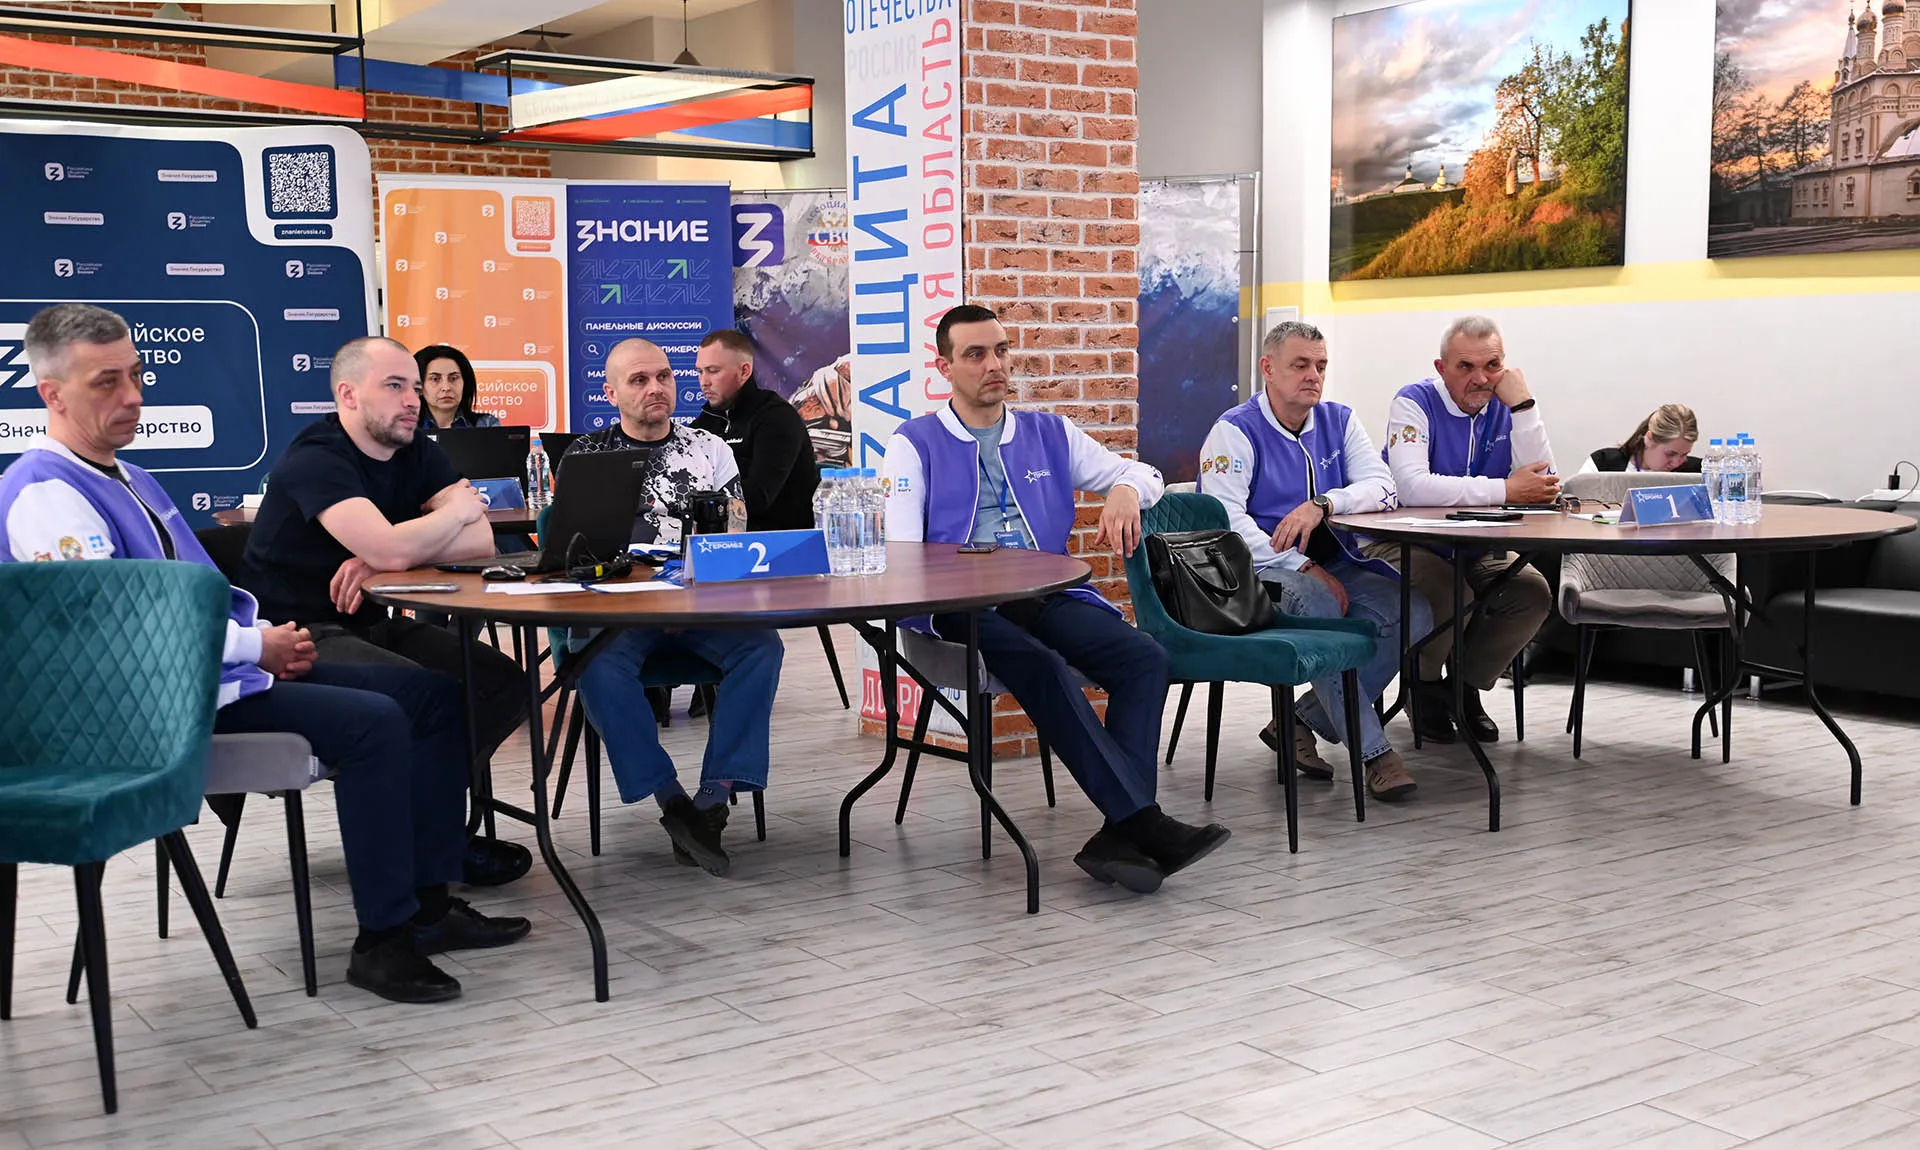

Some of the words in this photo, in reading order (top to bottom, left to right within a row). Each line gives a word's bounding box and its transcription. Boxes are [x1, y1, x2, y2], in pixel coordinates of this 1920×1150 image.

[846, 0, 952, 34] ОТЕЧЕС
[921, 18, 955, 249] ОБЛАСТЬ
[129, 323, 205, 343] йское
[585, 322, 644, 331] ПАНЕЛЬНЫЕ
[646, 321, 702, 330] ДИСКУССИИ
[662, 345, 700, 353] ПИКЕРО
[1666, 494, 1681, 518] 1
[747, 541, 771, 574] 2
[862, 676, 924, 721] ДОРО
